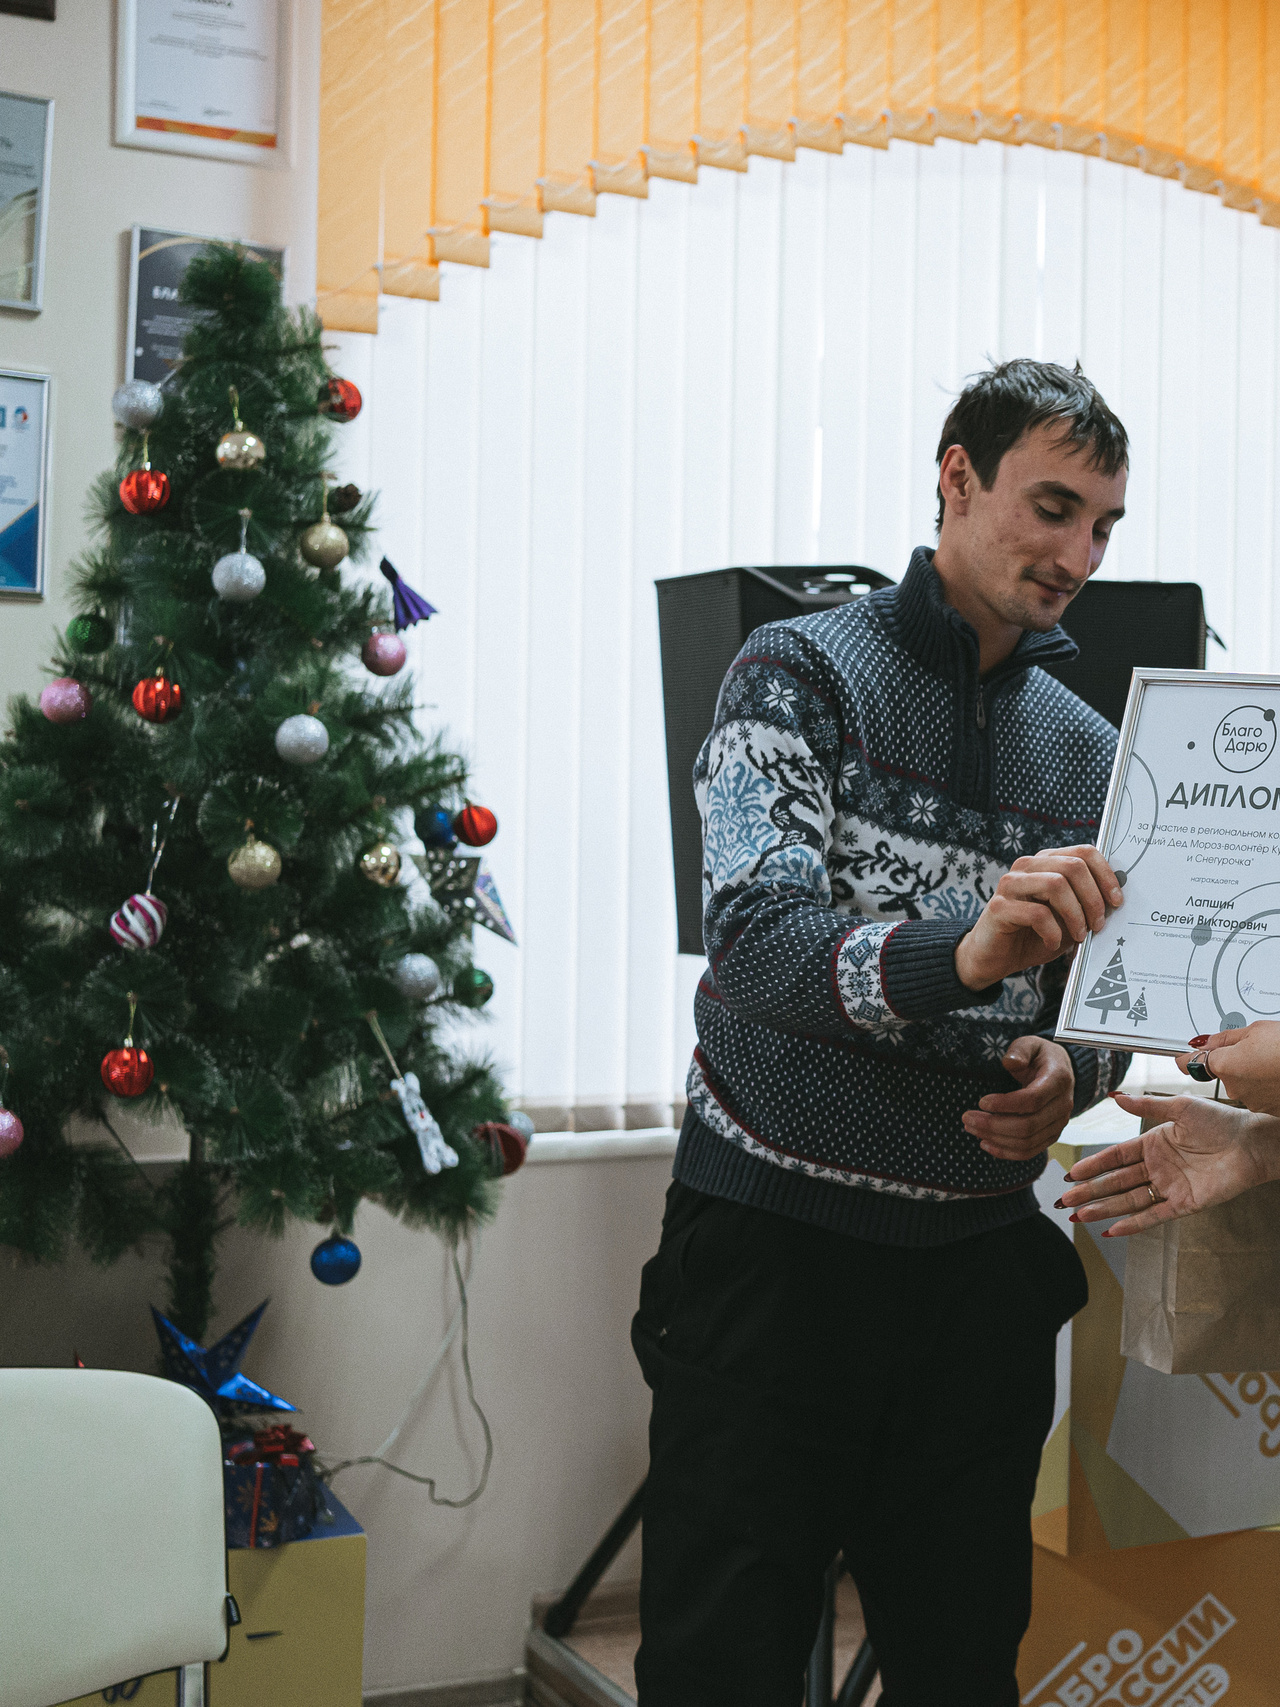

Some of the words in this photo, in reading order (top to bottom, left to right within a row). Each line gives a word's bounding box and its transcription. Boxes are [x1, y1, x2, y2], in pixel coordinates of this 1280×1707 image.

[1221, 722, 1263, 738] Благо
[1224, 737, 1268, 755] Дарю
[1137, 822, 1149, 831] за
[1151, 823, 1189, 834] участие
[1190, 826, 1196, 834] в
[1197, 826, 1267, 840] региональном
[1167, 837, 1188, 849] Дед
[1186, 855, 1193, 863] и
[1190, 876, 1239, 886] награждается
[1185, 895, 1235, 910] Лапшин
[1150, 910, 1194, 926] Сергей
[1197, 914, 1268, 932] Викторович
